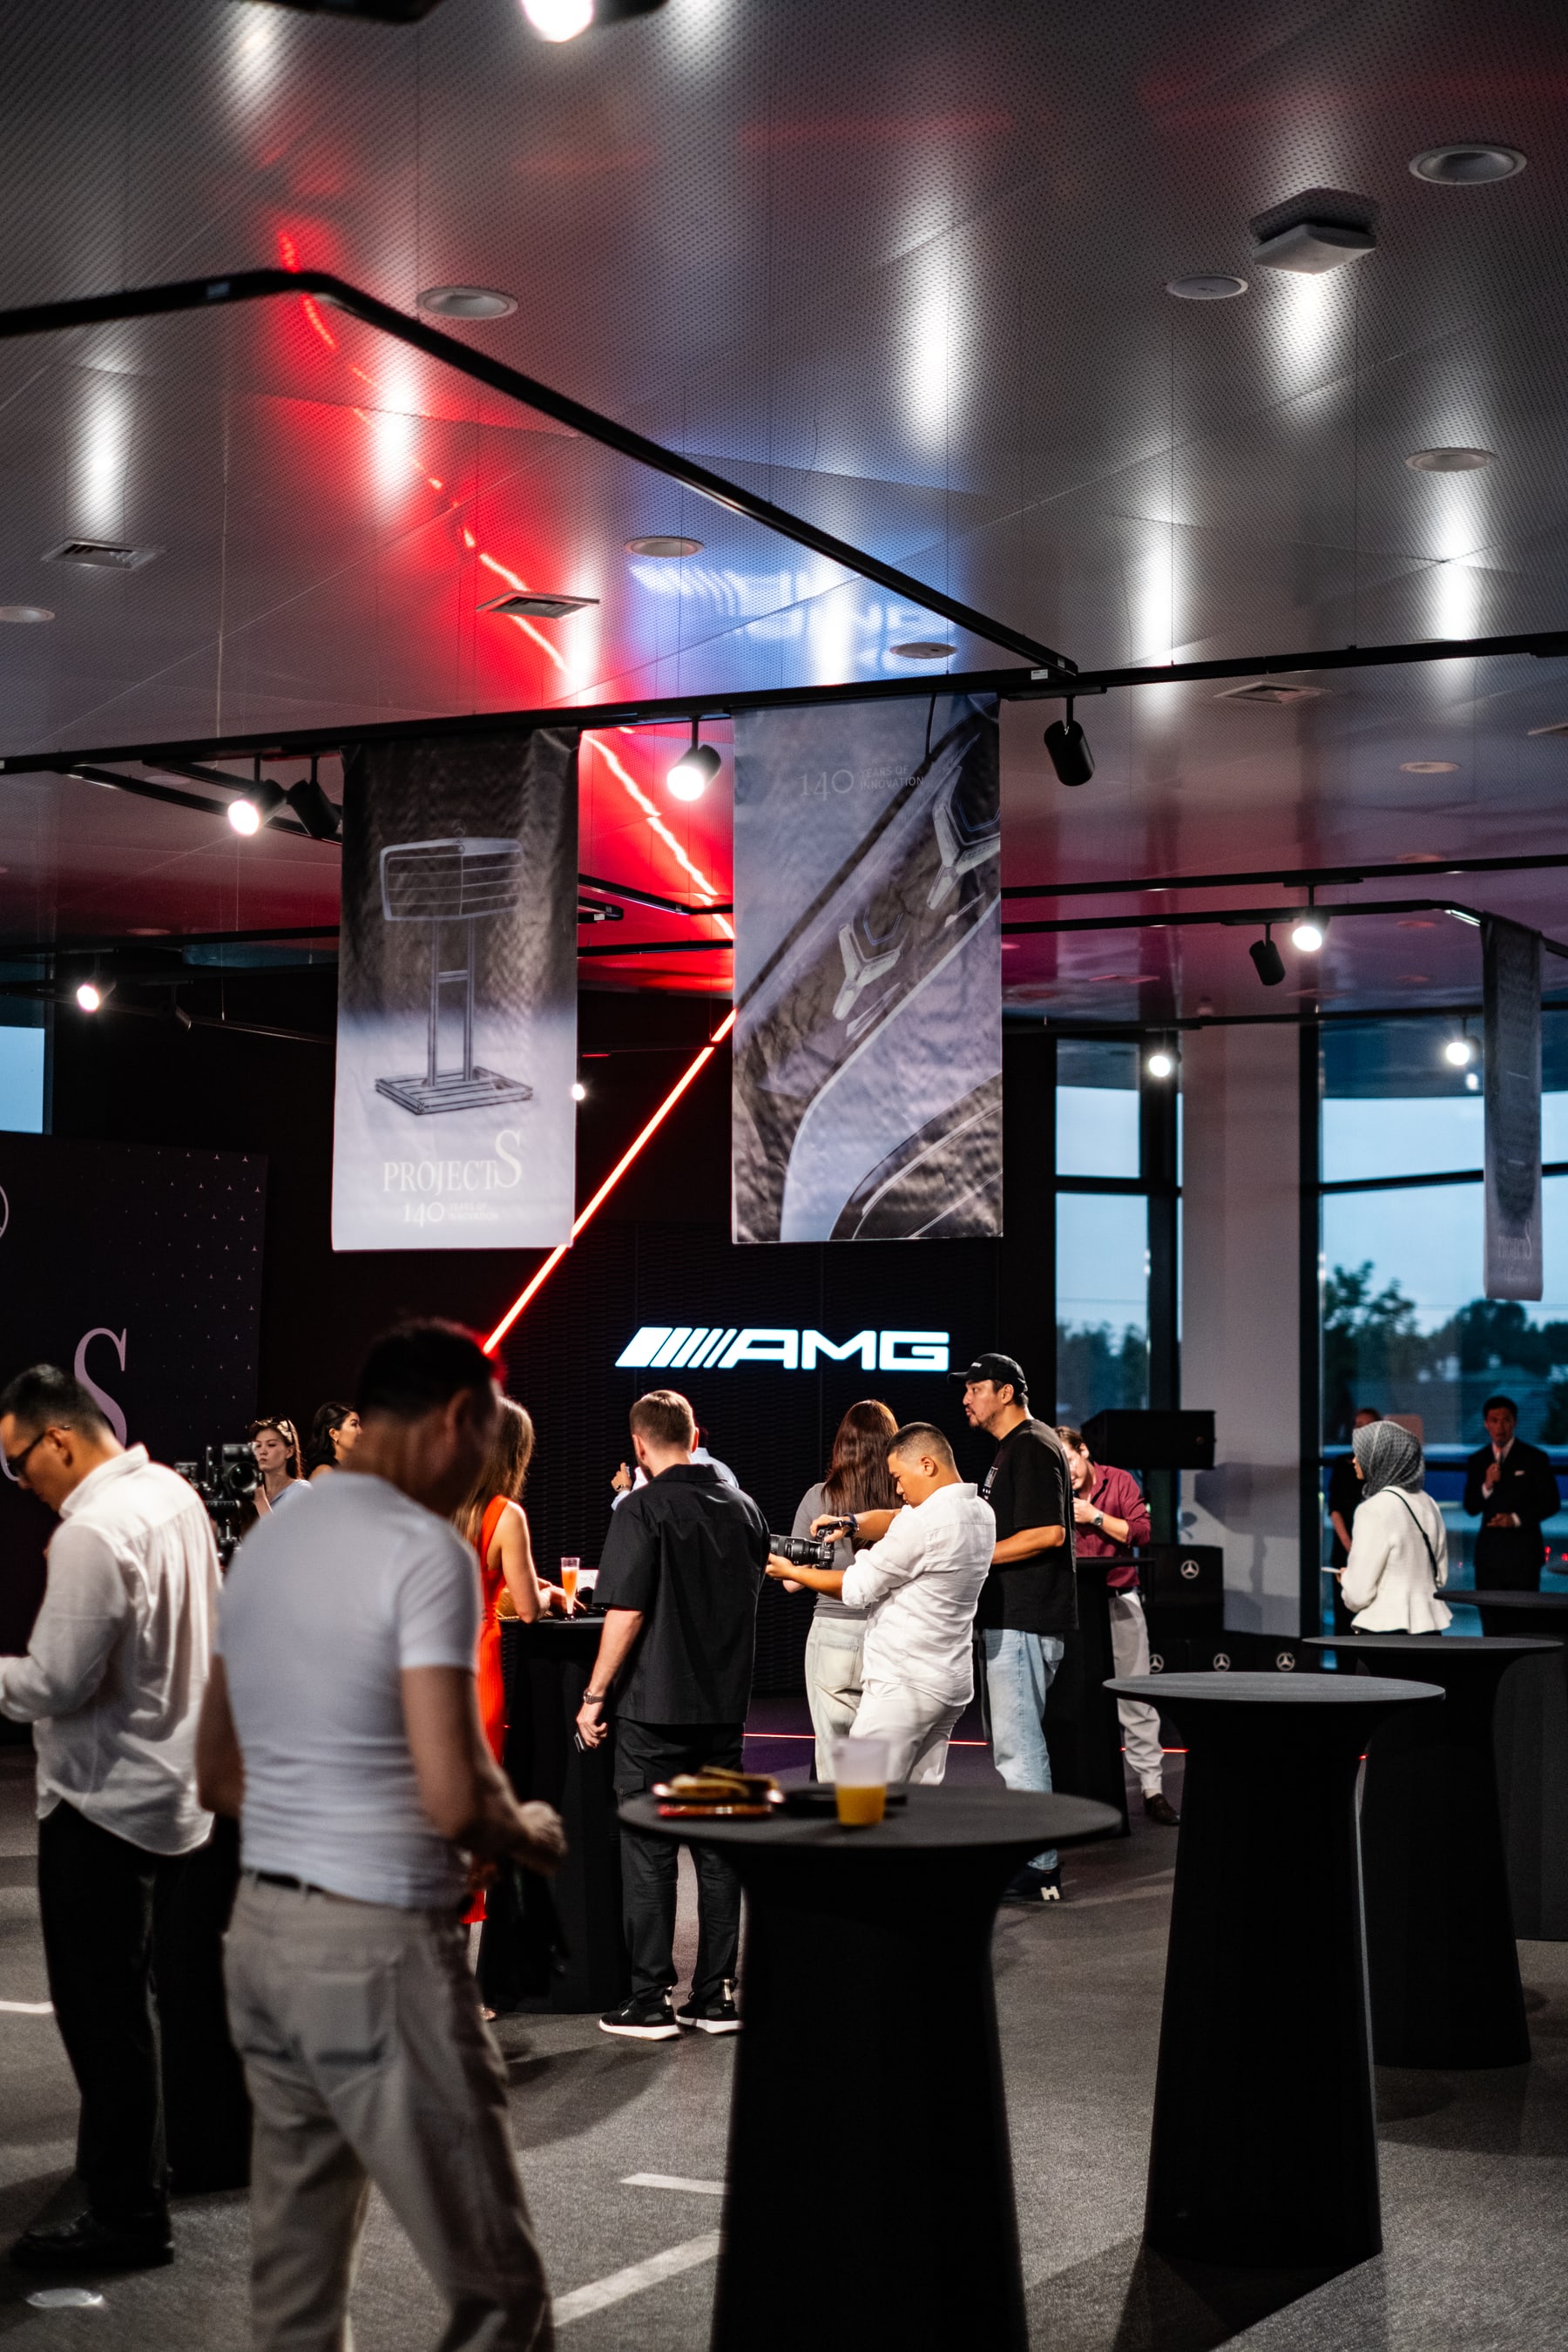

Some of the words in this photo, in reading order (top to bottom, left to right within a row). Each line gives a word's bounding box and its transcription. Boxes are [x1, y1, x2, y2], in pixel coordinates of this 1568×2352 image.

[797, 769, 855, 801] 140
[859, 775, 924, 791] INNOVATION
[860, 767, 893, 779] YEARS
[895, 765, 909, 775] OF
[402, 1201, 446, 1228] 140
[717, 1328, 950, 1371] AMG
